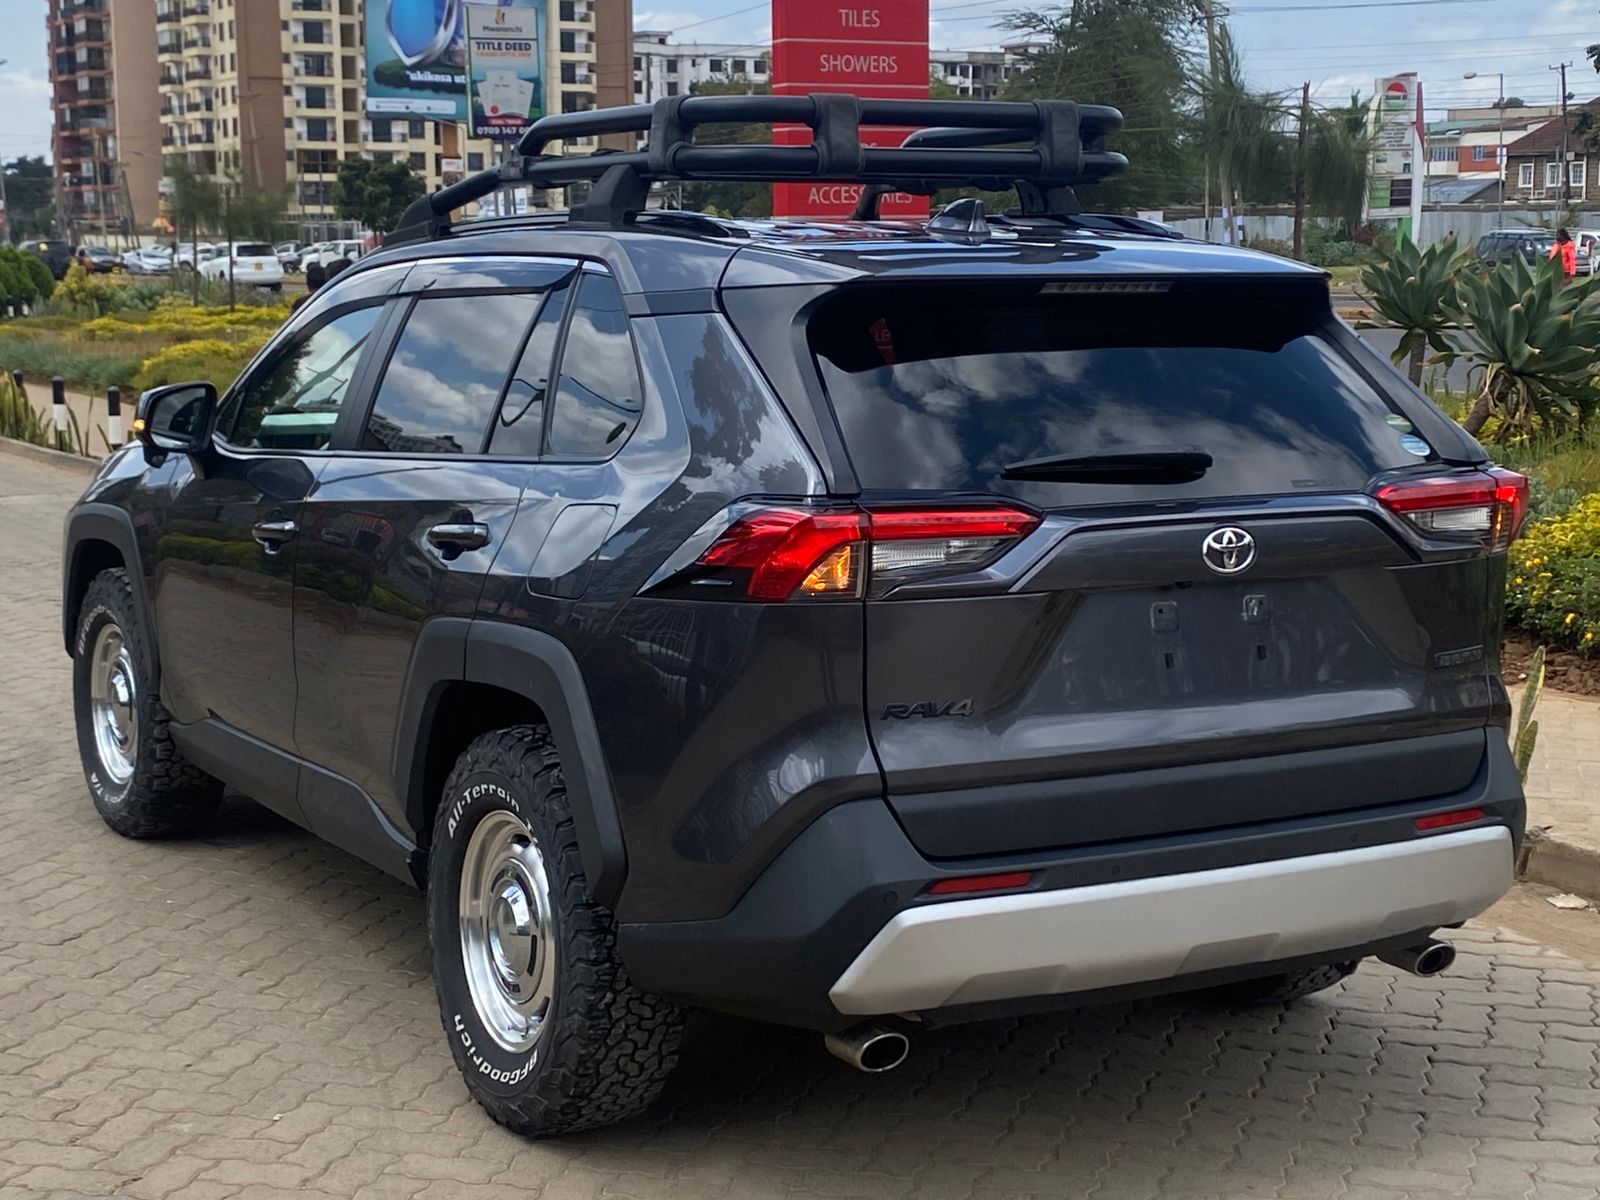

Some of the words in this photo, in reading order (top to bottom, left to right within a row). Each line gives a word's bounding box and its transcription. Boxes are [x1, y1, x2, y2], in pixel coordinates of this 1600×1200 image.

[838, 9, 881, 28] TILES
[476, 41, 503, 51] TITLE
[505, 42, 532, 51] DEED
[820, 54, 898, 74] SHOWERS
[808, 186, 913, 204] ACCESRIES
[881, 699, 976, 720] RAV4
[447, 783, 520, 839] All-Terrain
[454, 1014, 538, 1085] BFGoodrich
